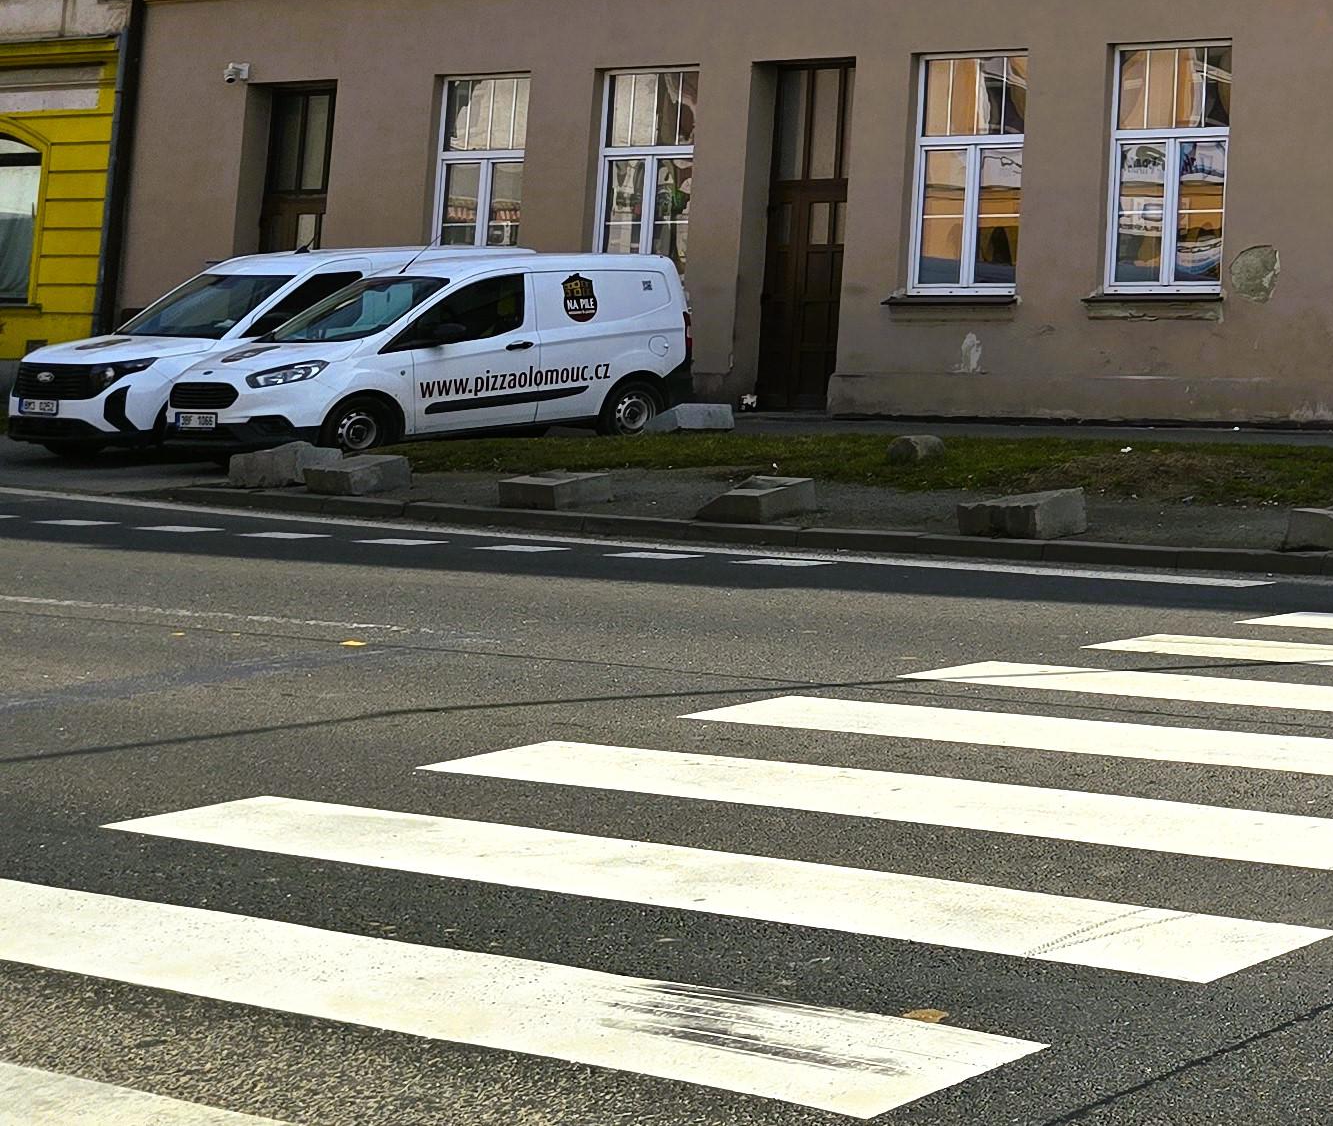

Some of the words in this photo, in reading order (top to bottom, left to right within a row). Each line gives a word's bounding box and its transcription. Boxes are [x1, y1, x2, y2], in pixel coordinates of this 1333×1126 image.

[567, 298, 579, 310] NA
[579, 297, 595, 310] PILE
[419, 362, 611, 398] www.pizzaolomouc.cz
